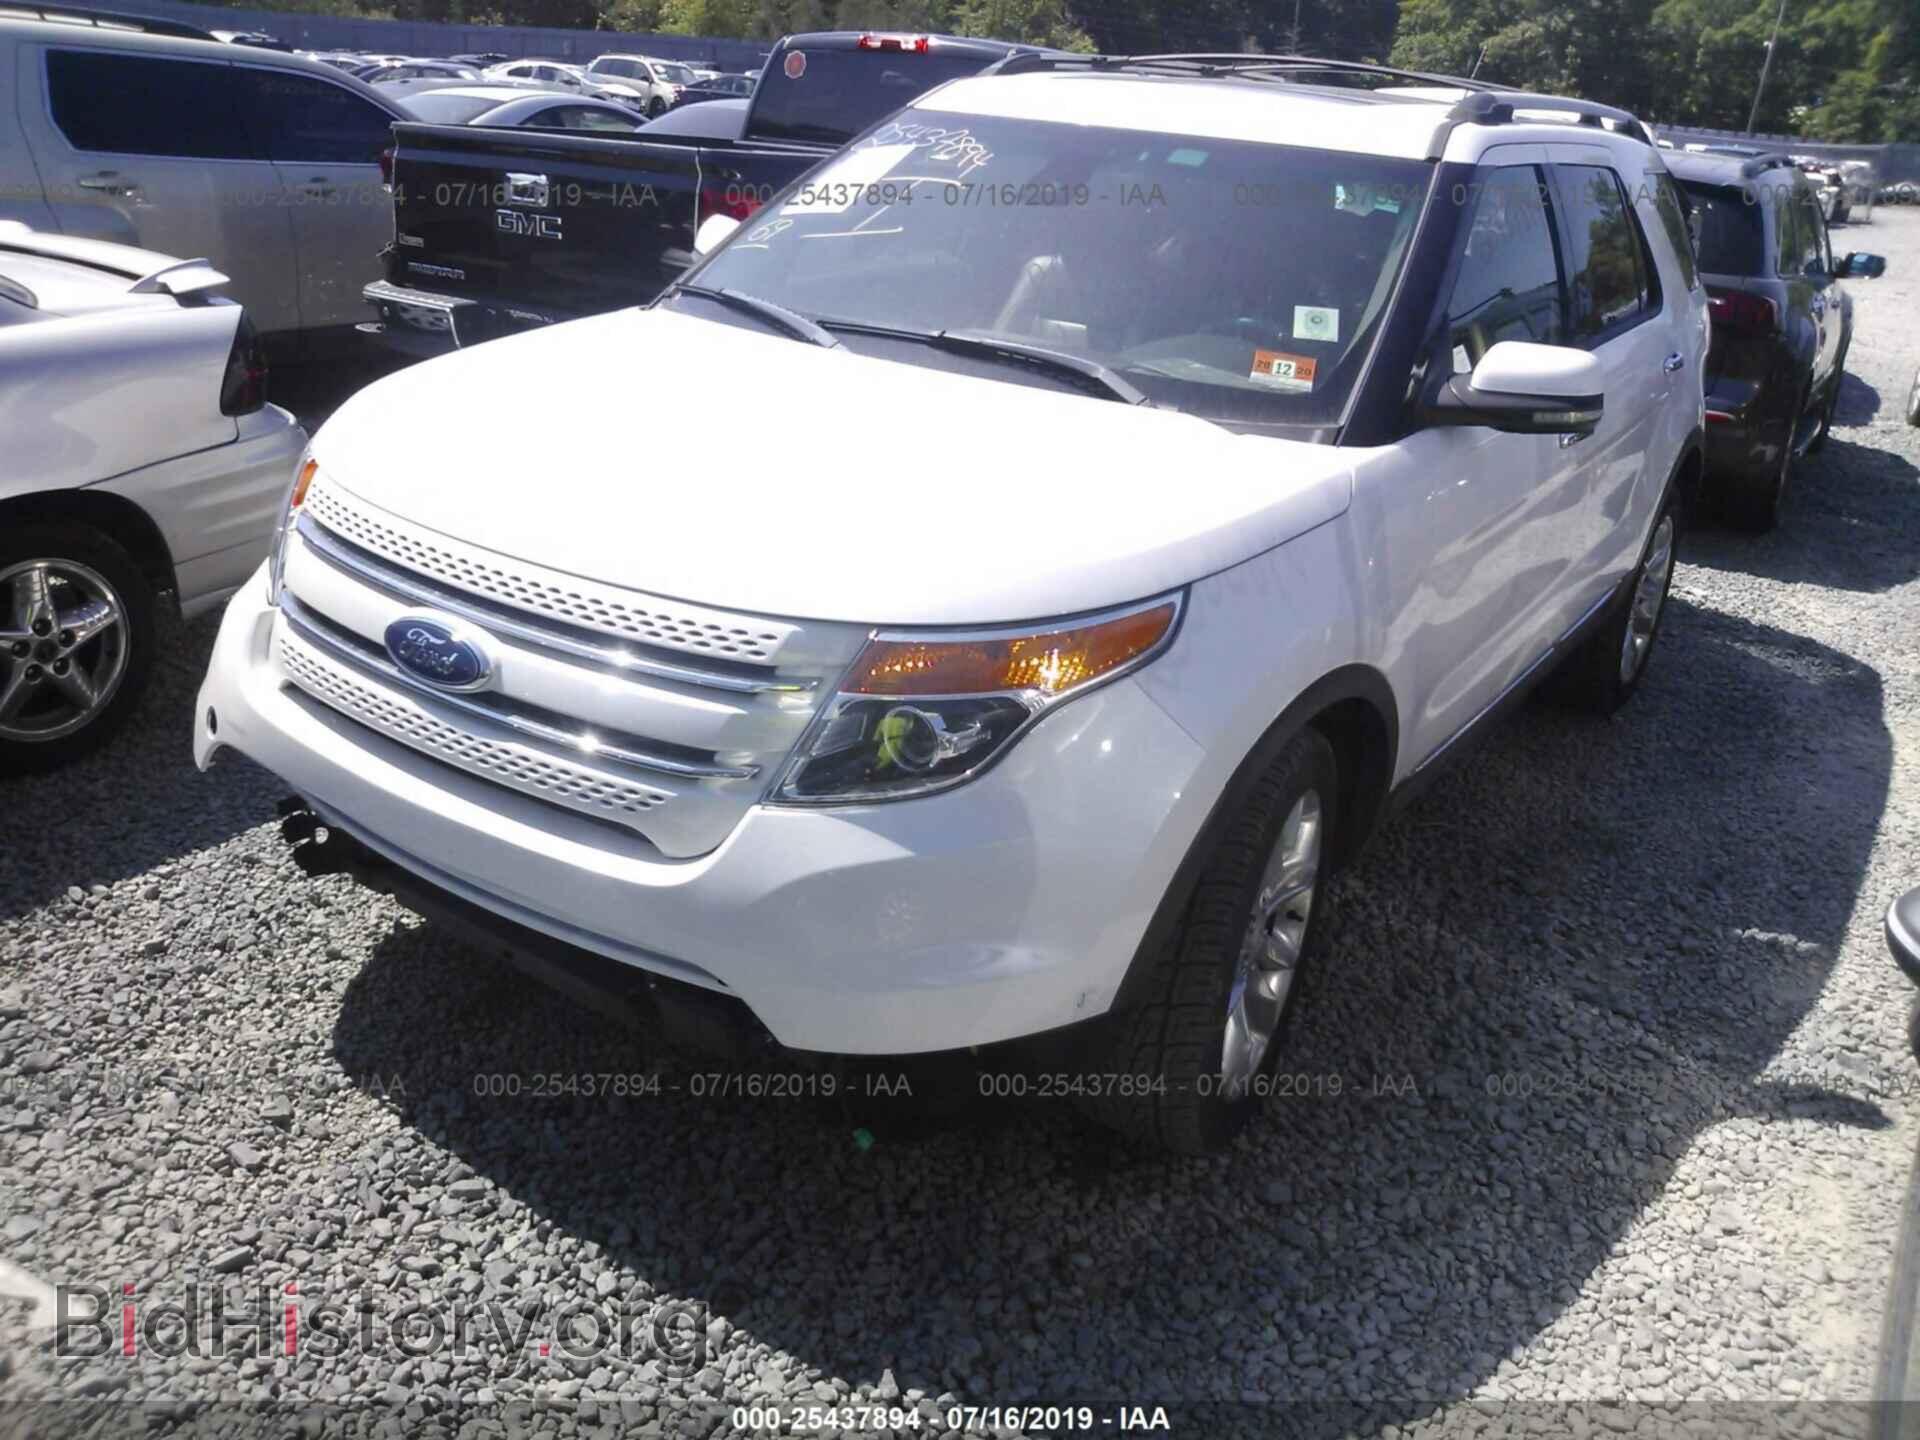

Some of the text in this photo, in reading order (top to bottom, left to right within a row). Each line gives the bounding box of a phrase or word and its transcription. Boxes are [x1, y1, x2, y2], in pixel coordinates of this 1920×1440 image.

[495, 208, 563, 241] GMC
[1275, 362, 1292, 376] 12
[1296, 367, 1312, 377] 20
